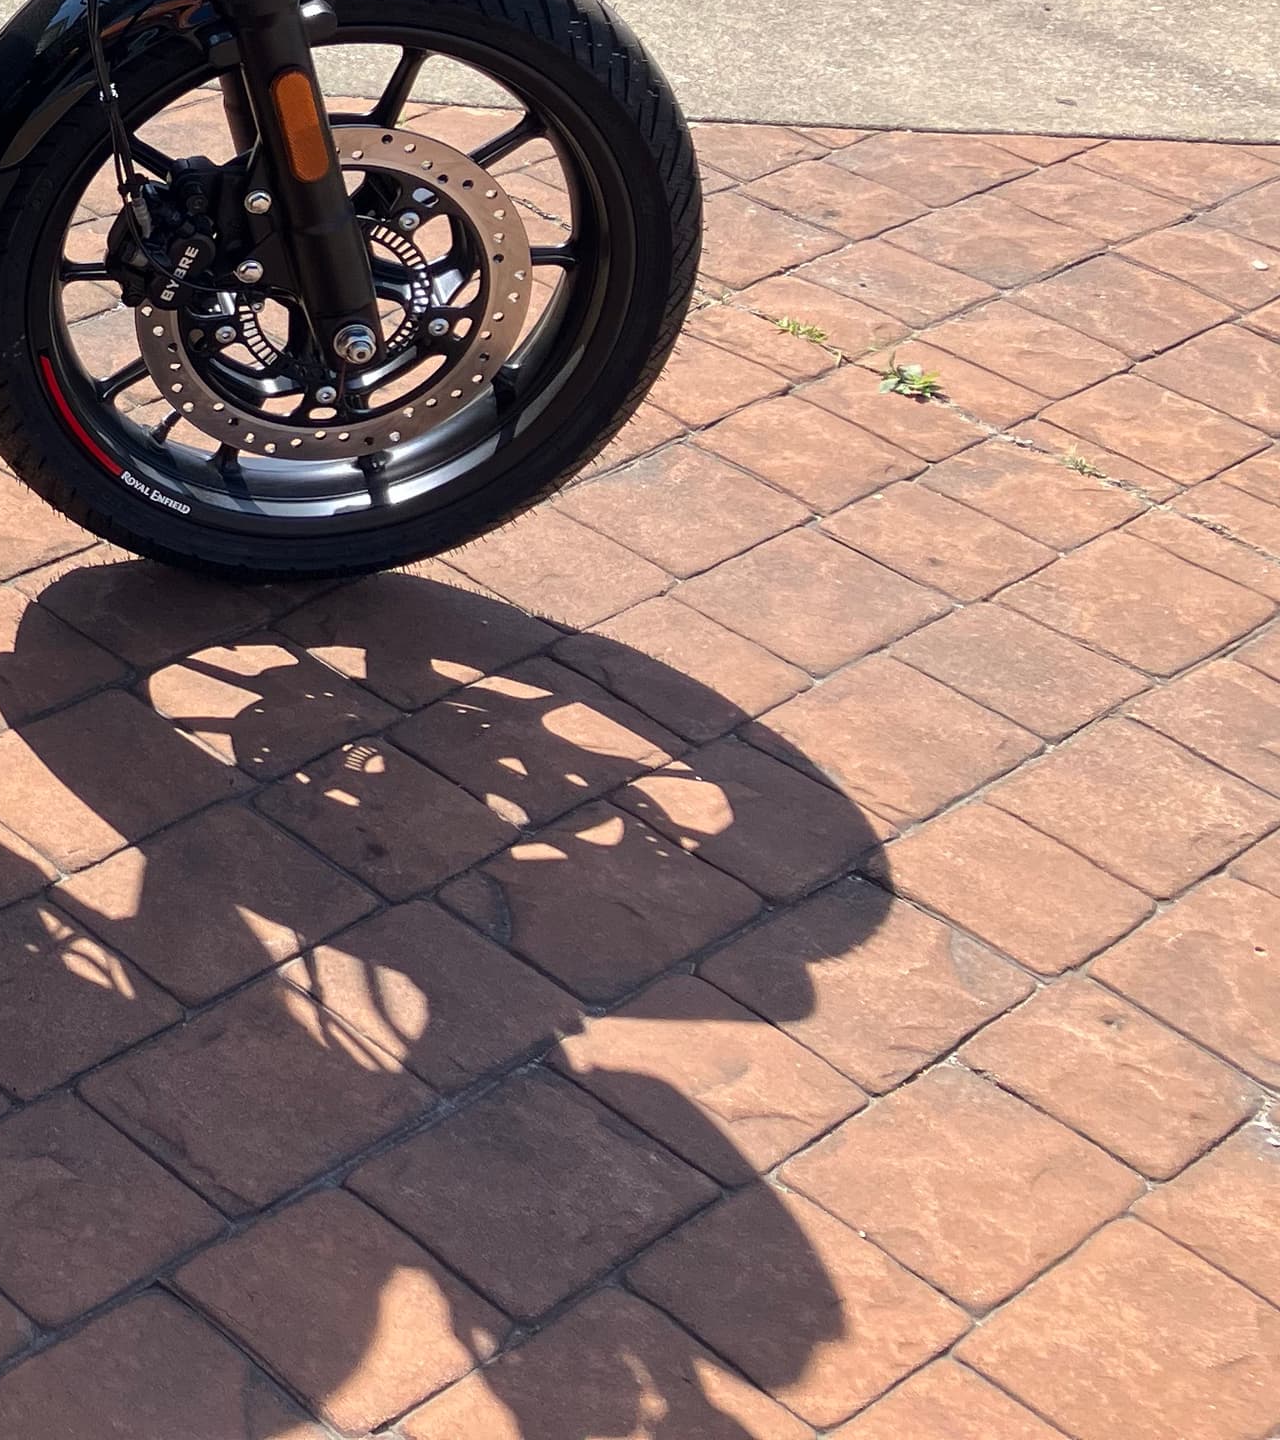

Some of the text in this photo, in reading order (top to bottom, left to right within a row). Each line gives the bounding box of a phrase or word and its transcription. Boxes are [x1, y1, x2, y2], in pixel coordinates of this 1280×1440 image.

[160, 246, 199, 302] BYBRE
[120, 470, 191, 514] ROYAL ENFIELD
